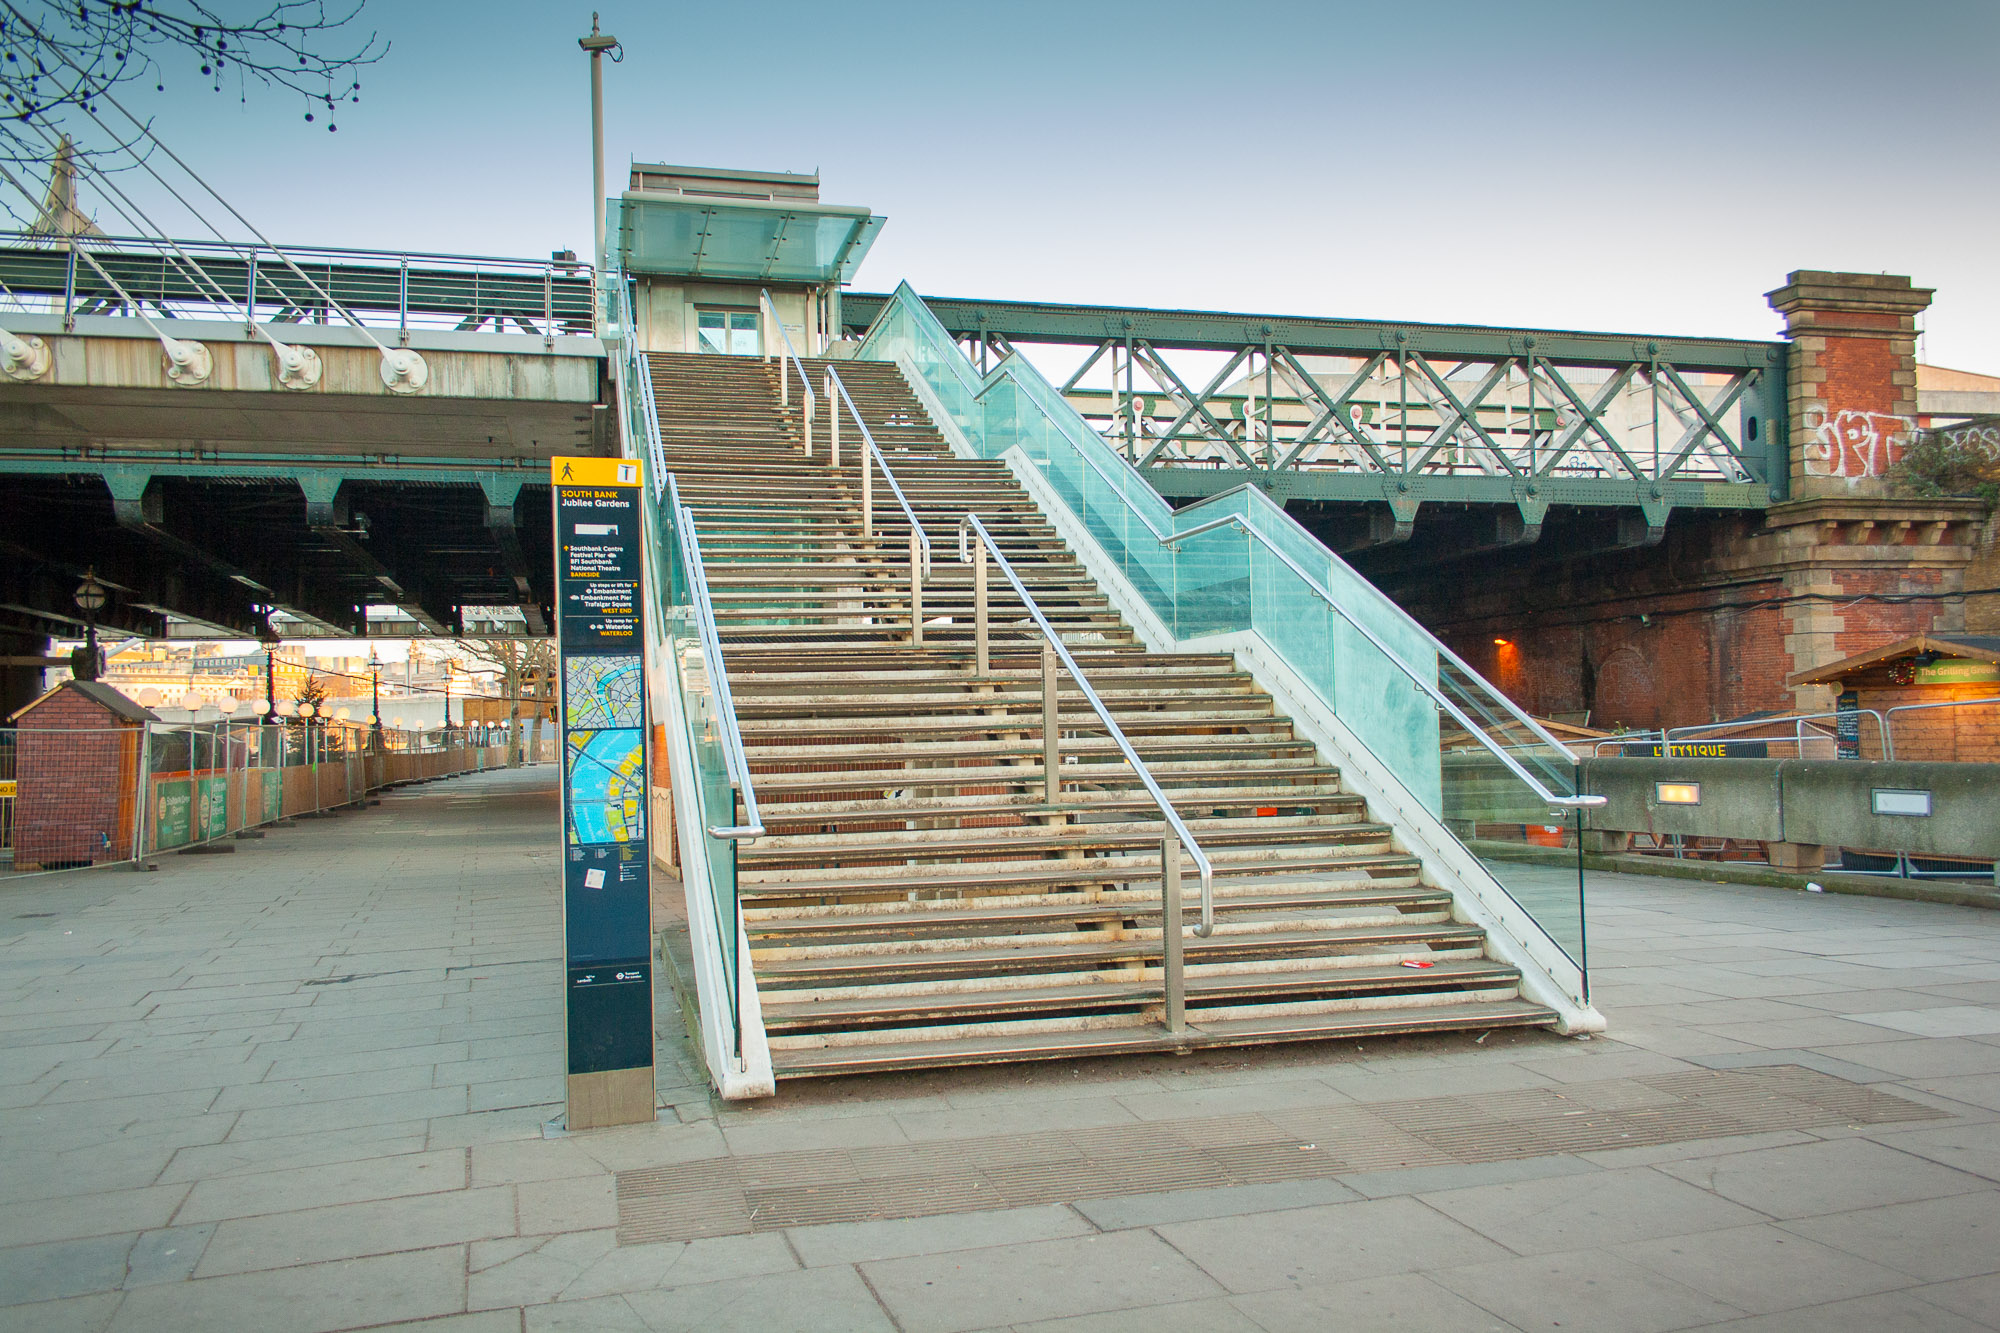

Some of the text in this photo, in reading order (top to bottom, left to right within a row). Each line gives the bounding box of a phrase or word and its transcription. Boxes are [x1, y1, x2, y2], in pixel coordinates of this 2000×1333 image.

[561, 489, 618, 498] SOUTH BANK
[561, 498, 630, 508] Jubilee Gardens
[1920, 665, 1997, 677] The Grilling Greek
